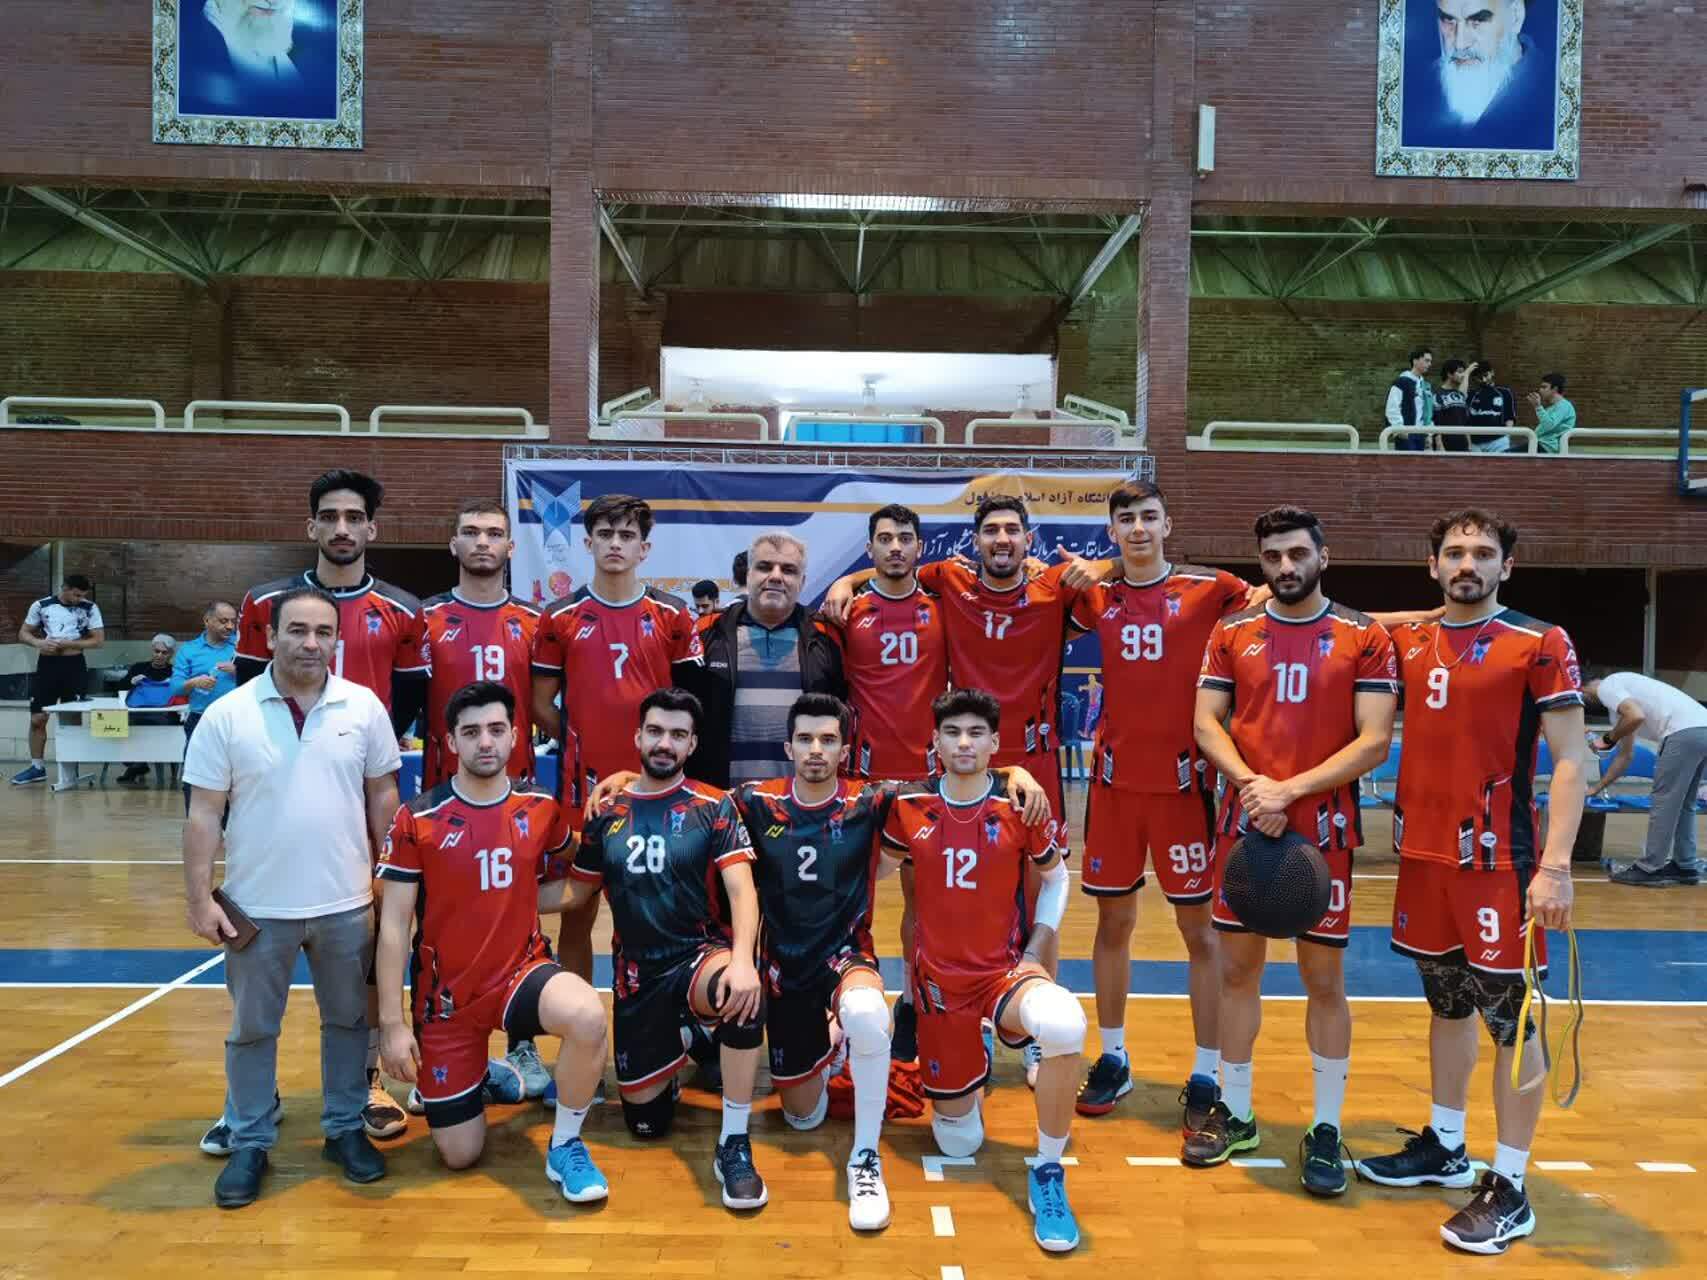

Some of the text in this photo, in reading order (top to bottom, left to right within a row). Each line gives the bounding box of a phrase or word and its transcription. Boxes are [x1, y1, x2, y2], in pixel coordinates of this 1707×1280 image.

[1049, 490, 1072, 505] آزاد
[1078, 490, 1109, 503] انشگاه
[922, 530, 949, 556] آزا
[983, 610, 1013, 640] 17
[1121, 623, 1163, 661] 99
[469, 644, 505, 682] 19
[609, 642, 629, 679] 7
[879, 631, 918, 664] 20
[1272, 662, 1309, 704] 10
[1425, 667, 1450, 709] 9
[474, 846, 513, 891] 16
[625, 834, 666, 874] 28
[797, 845, 818, 881] 2
[942, 847, 978, 889] 12
[1168, 842, 1207, 874] 99
[1476, 907, 1501, 944] 9
